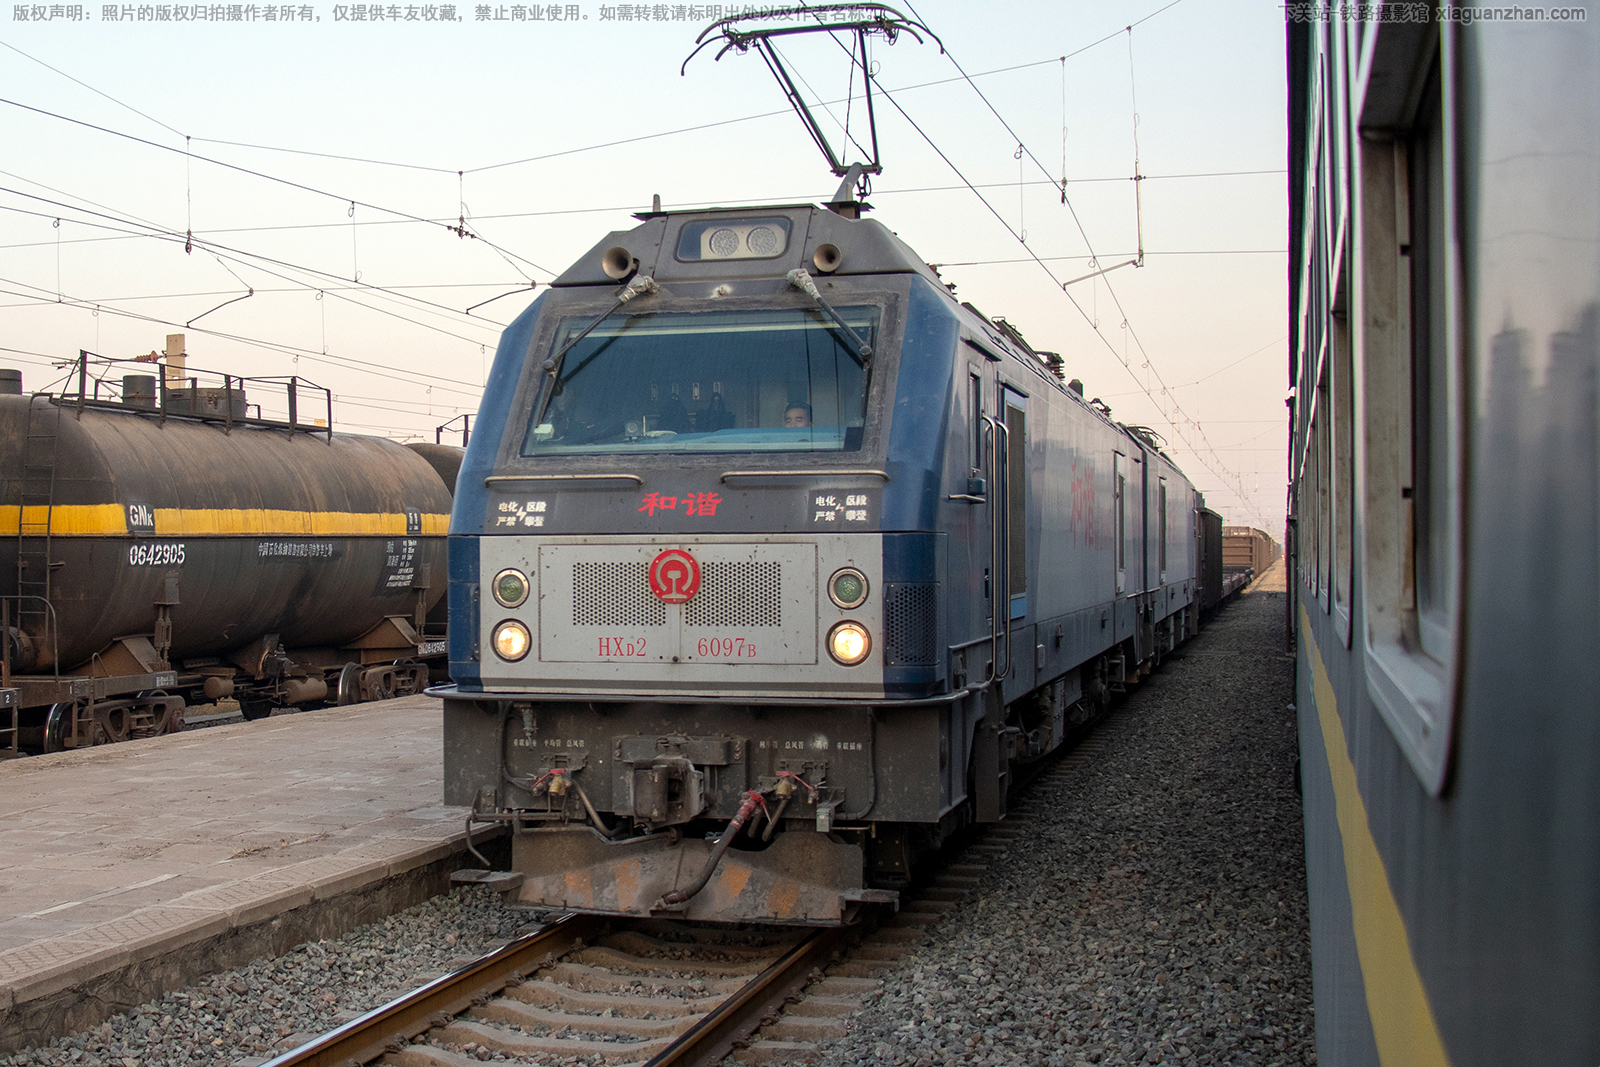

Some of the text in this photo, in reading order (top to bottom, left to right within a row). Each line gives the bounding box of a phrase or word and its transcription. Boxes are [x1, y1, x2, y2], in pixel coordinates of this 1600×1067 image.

[498, 502, 518, 512] 电化
[637, 491, 723, 516] 和谐
[815, 494, 867, 506] 电化 区段
[129, 543, 186, 566] 0642905
[598, 637, 757, 658] HXD2 6097B
[5, 694, 10, 704] 2
